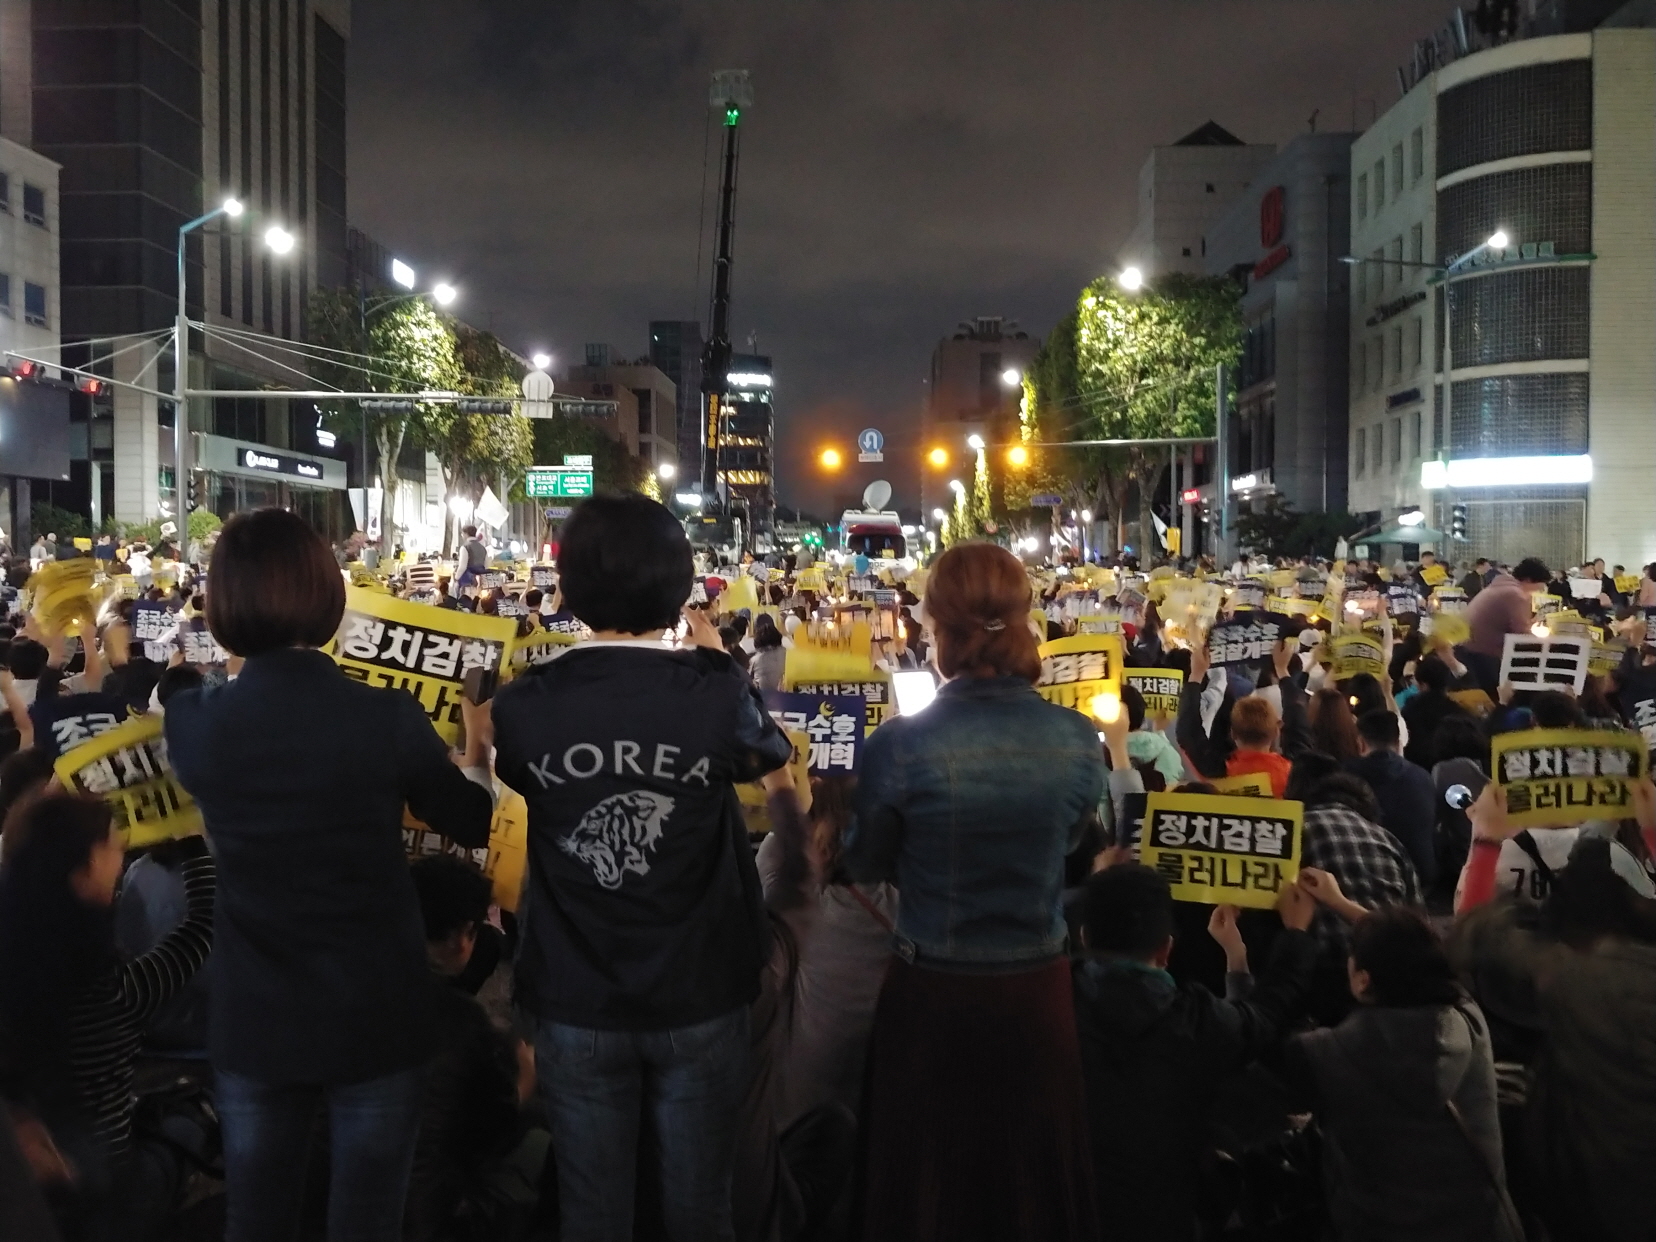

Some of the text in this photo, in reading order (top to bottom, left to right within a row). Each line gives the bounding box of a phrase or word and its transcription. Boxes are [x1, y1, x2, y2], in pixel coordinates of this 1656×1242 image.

[769, 710, 857, 742] 국수호
[527, 740, 711, 790] KOREA
[1157, 813, 1288, 856] 정치검찰
[1156, 851, 1284, 894] 물러나라
